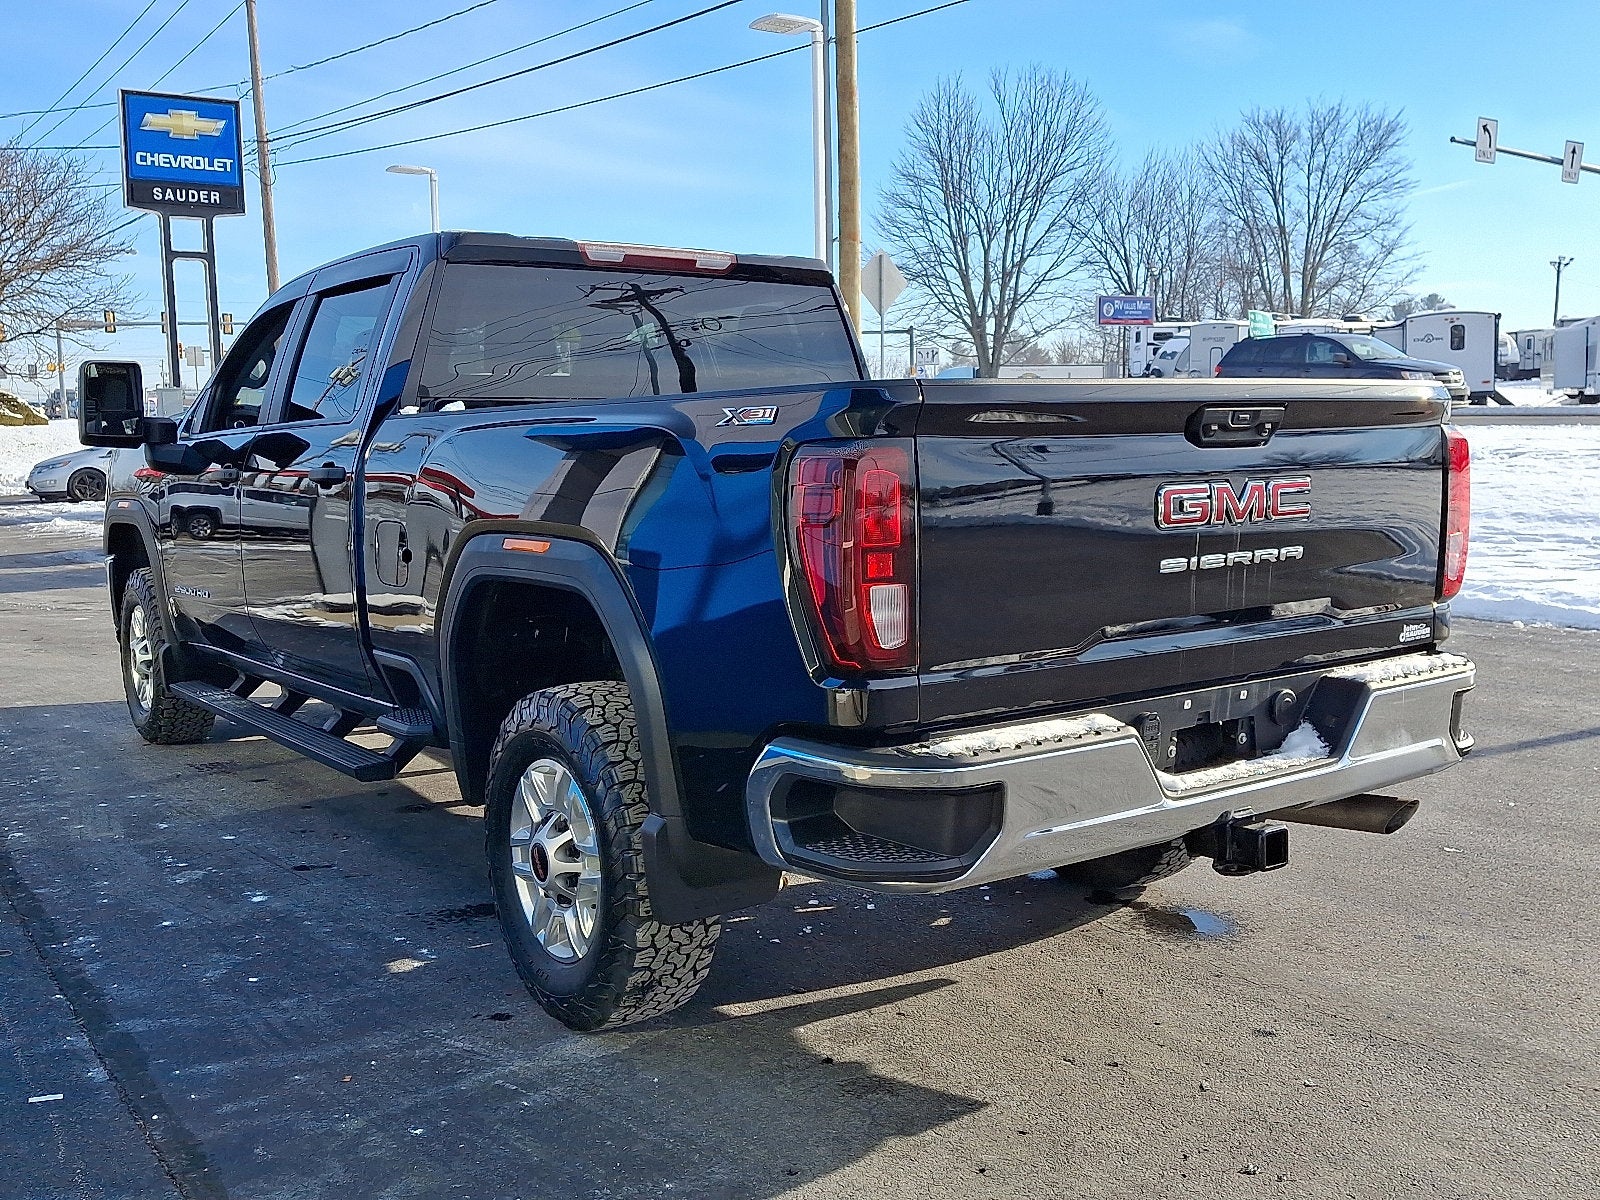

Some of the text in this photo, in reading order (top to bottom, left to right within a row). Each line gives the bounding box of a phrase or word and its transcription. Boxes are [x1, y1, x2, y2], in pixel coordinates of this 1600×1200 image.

[135, 151, 234, 173] CHEVROLET
[152, 187, 221, 205] SAUDER
[1114, 300, 1124, 310] RV
[714, 405, 778, 427] X31
[1154, 474, 1312, 531] GMC
[1159, 545, 1305, 575] SIERRA
